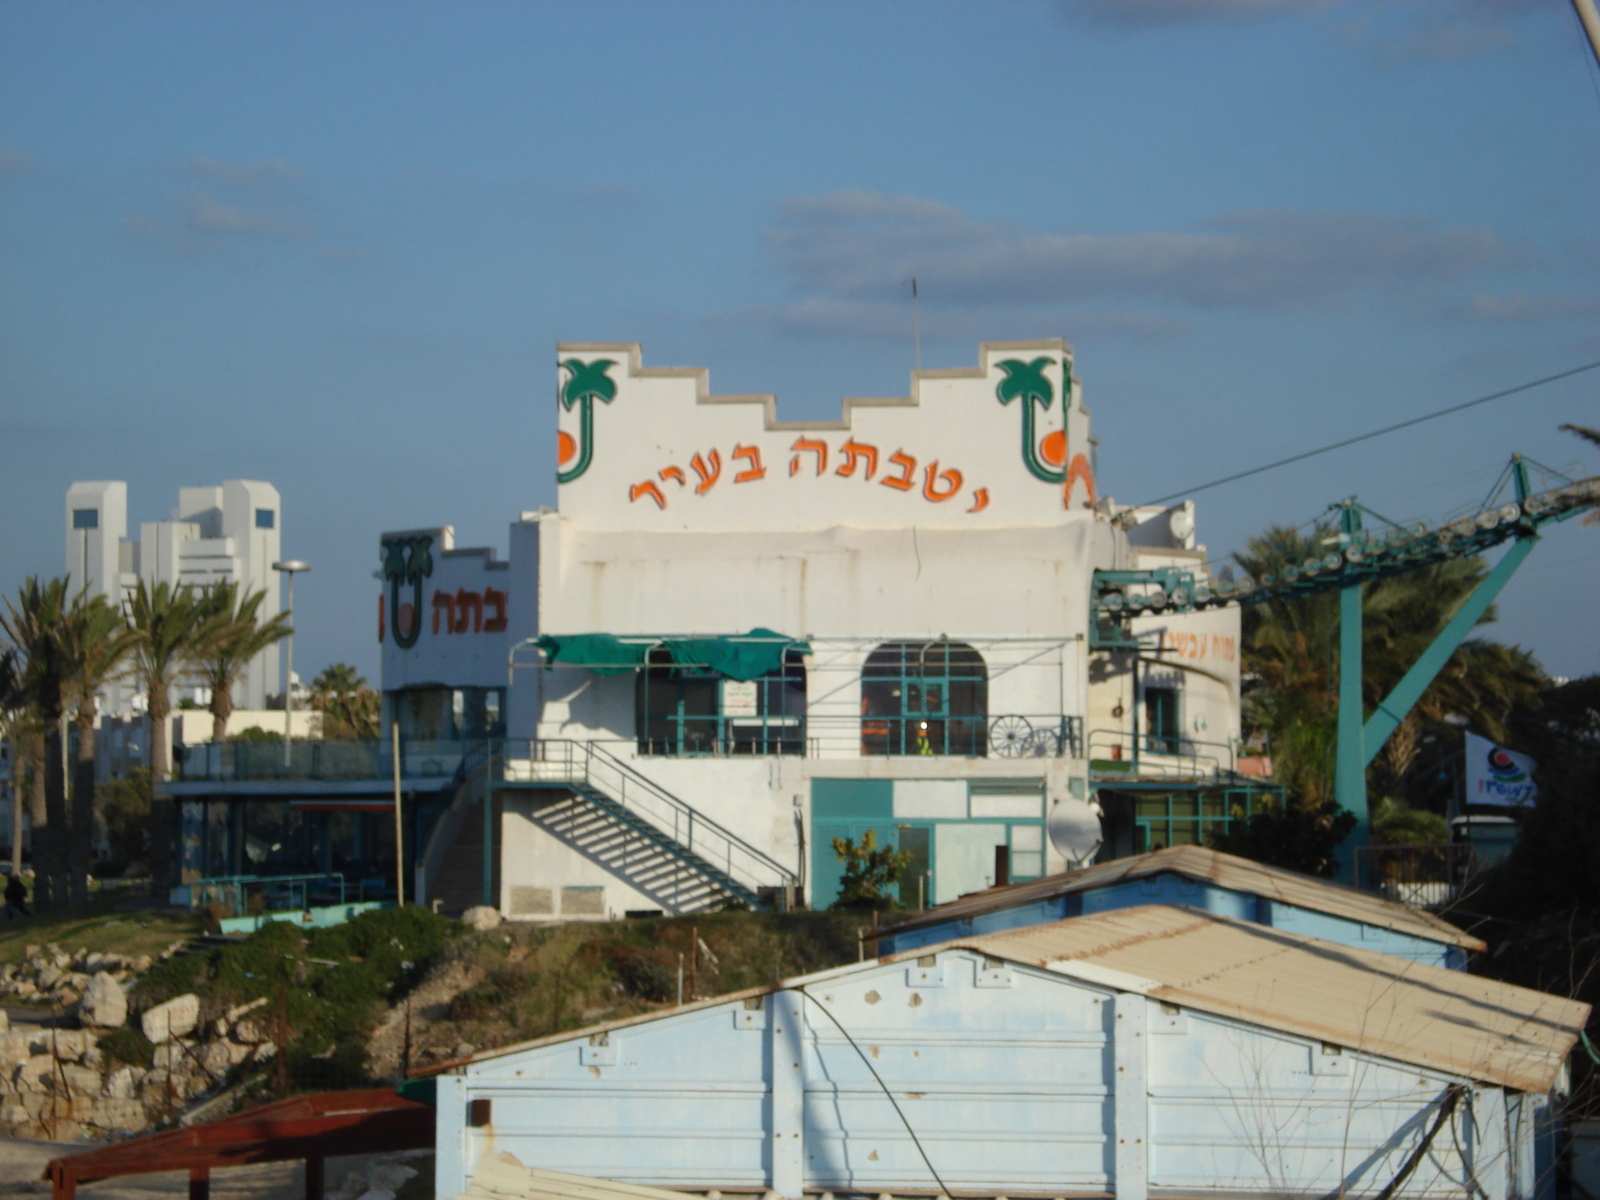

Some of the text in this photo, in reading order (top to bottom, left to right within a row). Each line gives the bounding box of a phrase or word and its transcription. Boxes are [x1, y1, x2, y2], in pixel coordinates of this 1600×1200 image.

[629, 444, 768, 509] בעיר
[789, 436, 990, 513] יטבתה
[431, 587, 508, 634] בתה
